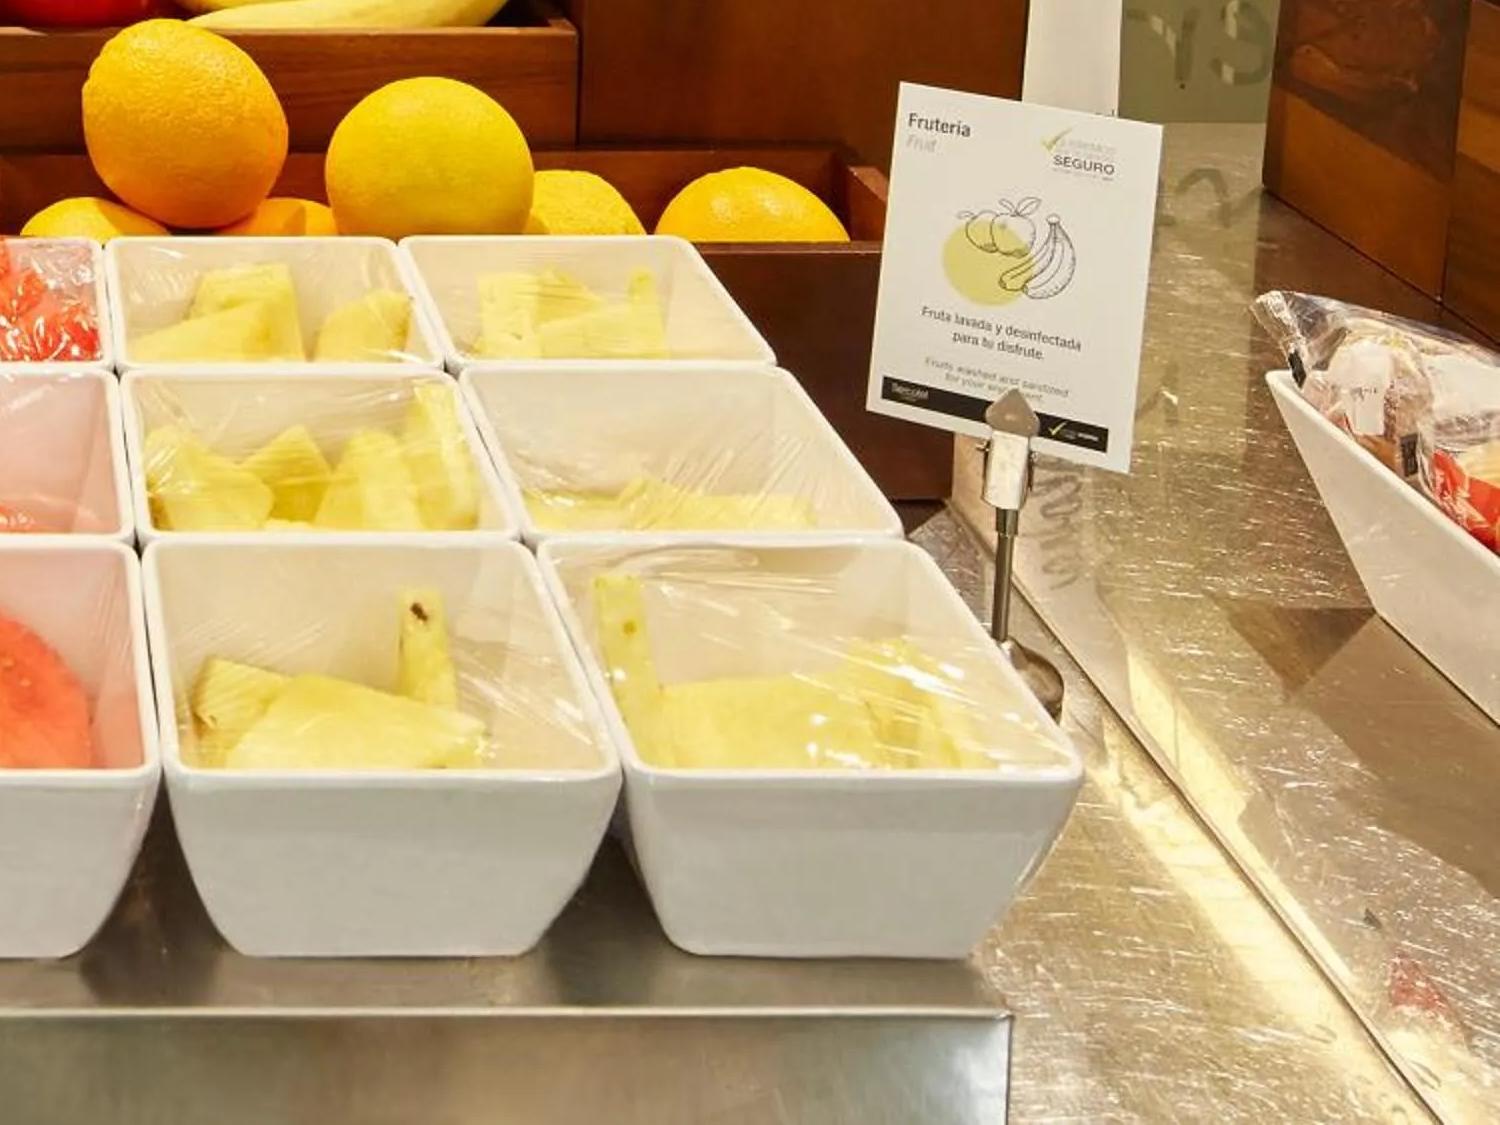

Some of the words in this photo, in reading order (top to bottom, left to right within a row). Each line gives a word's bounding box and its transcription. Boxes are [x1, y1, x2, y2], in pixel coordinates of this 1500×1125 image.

[1053, 154, 1115, 176] SEGURO
[920, 306, 952, 323] Fruta
[954, 313, 992, 332] lavada
[995, 324, 1003, 336] y
[1005, 325, 1082, 352] desinfectada
[952, 331, 979, 346] para
